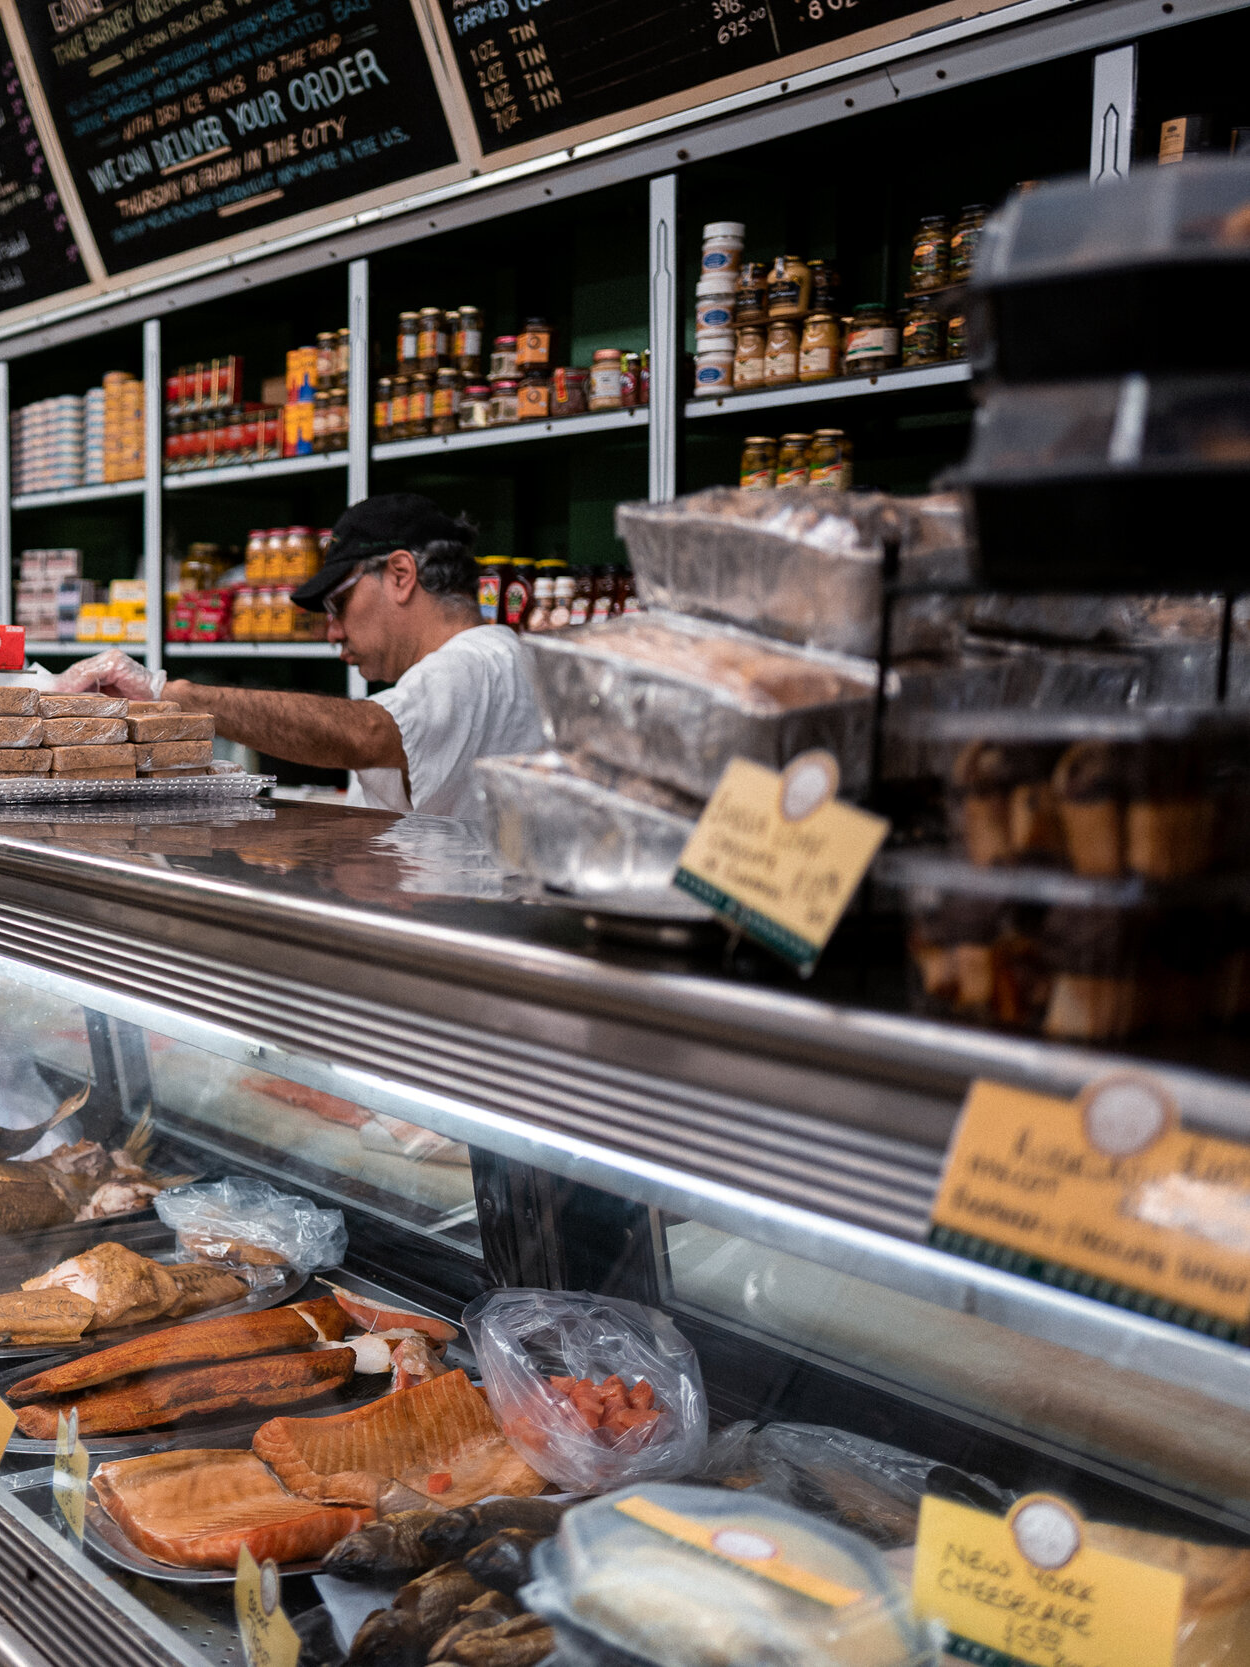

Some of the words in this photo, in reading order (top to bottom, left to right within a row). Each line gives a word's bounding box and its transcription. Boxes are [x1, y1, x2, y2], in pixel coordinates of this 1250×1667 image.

[84, 5, 135, 52] BARNEY
[507, 19, 538, 45] TIN
[277, 48, 308, 74] THE
[307, 32, 342, 61] TRIP
[515, 43, 547, 70] TIN
[522, 65, 554, 91] TIN
[528, 86, 563, 113] TIN
[87, 158, 124, 195] WE
[117, 145, 153, 183] CAN
[150, 115, 231, 168] DELIVER
[225, 89, 288, 137] YOUR
[288, 48, 390, 112] ORDER
[114, 180, 181, 218] THURSDAY
[243, 149, 262, 173] IN
[263, 133, 300, 165] THE
[302, 114, 348, 150] CITY
